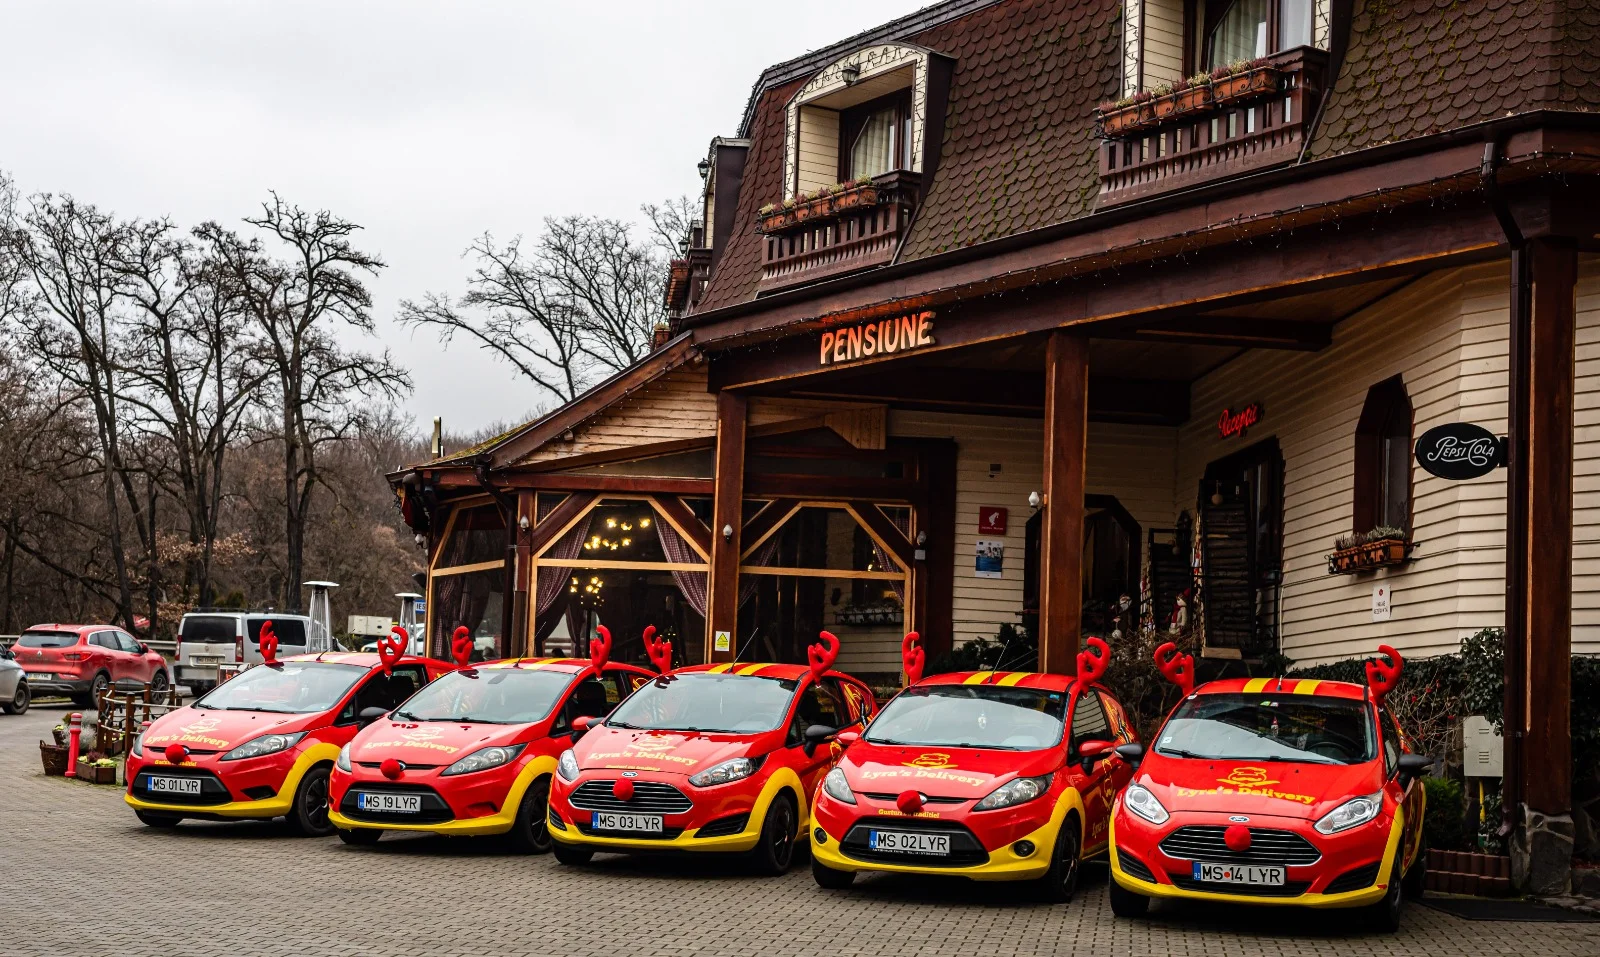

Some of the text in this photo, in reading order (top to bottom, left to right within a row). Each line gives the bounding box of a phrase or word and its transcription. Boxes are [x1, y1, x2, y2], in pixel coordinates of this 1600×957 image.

[820, 311, 936, 365] PENSIUNE
[144, 733, 230, 749] Lyra's Delivery
[364, 740, 460, 754] Lyra's Delivery
[588, 751, 699, 766] Lyra's Delivery
[153, 778, 166, 790] MS
[168, 779, 178, 791] 01
[179, 780, 198, 792] LYR
[861, 769, 986, 787] Lyra's Delivery
[365, 795, 380, 808] MS
[383, 796, 394, 808] 19
[395, 797, 418, 810] LYR
[1177, 786, 1316, 805] Lyra's Delivery
[599, 815, 616, 828] MS
[619, 816, 634, 829] 03
[635, 816, 660, 830] LYR
[877, 833, 947, 851] MS 02 LYR
[1202, 866, 1223, 880] MS
[1229, 867, 1244, 882] 14
[1248, 868, 1281, 883] LYR
